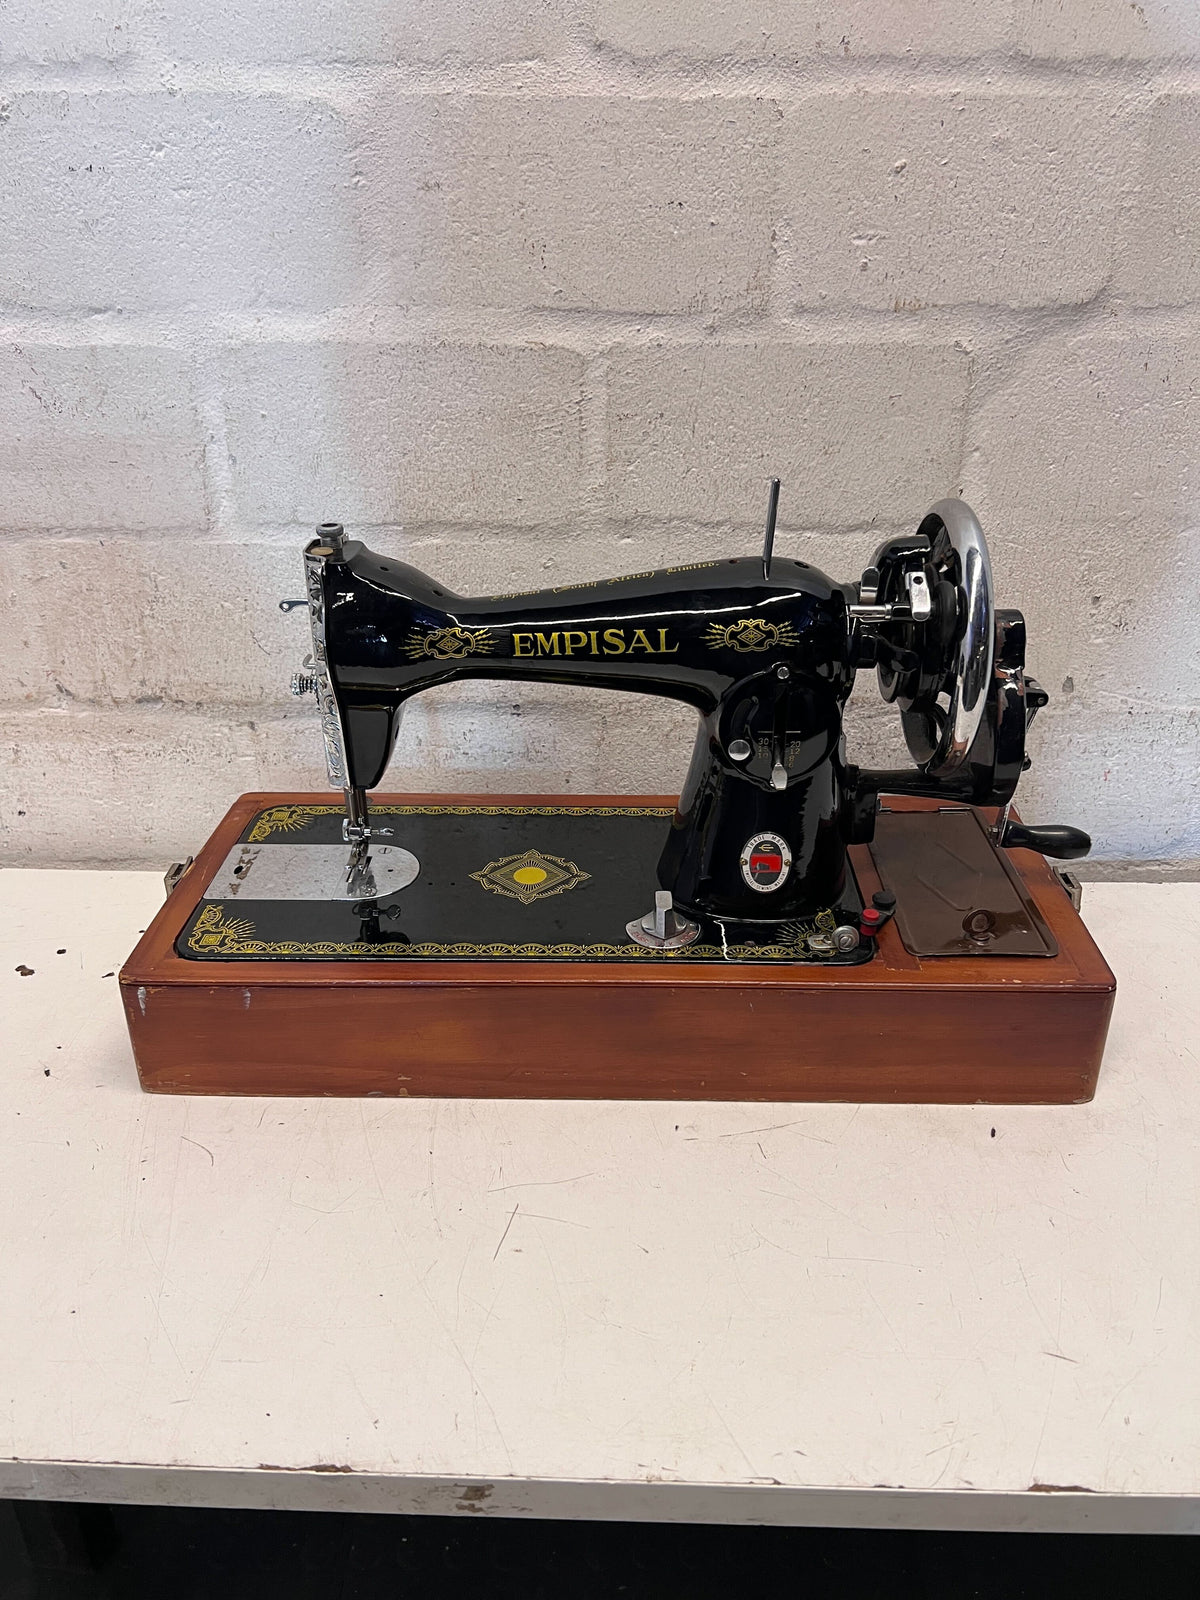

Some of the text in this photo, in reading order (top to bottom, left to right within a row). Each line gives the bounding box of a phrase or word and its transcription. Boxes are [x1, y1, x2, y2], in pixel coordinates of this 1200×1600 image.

[512, 628, 680, 657] EMPISAL
[758, 737, 770, 745] 30
[790, 740, 801, 748] 20
[771, 834, 787, 851] MARK
